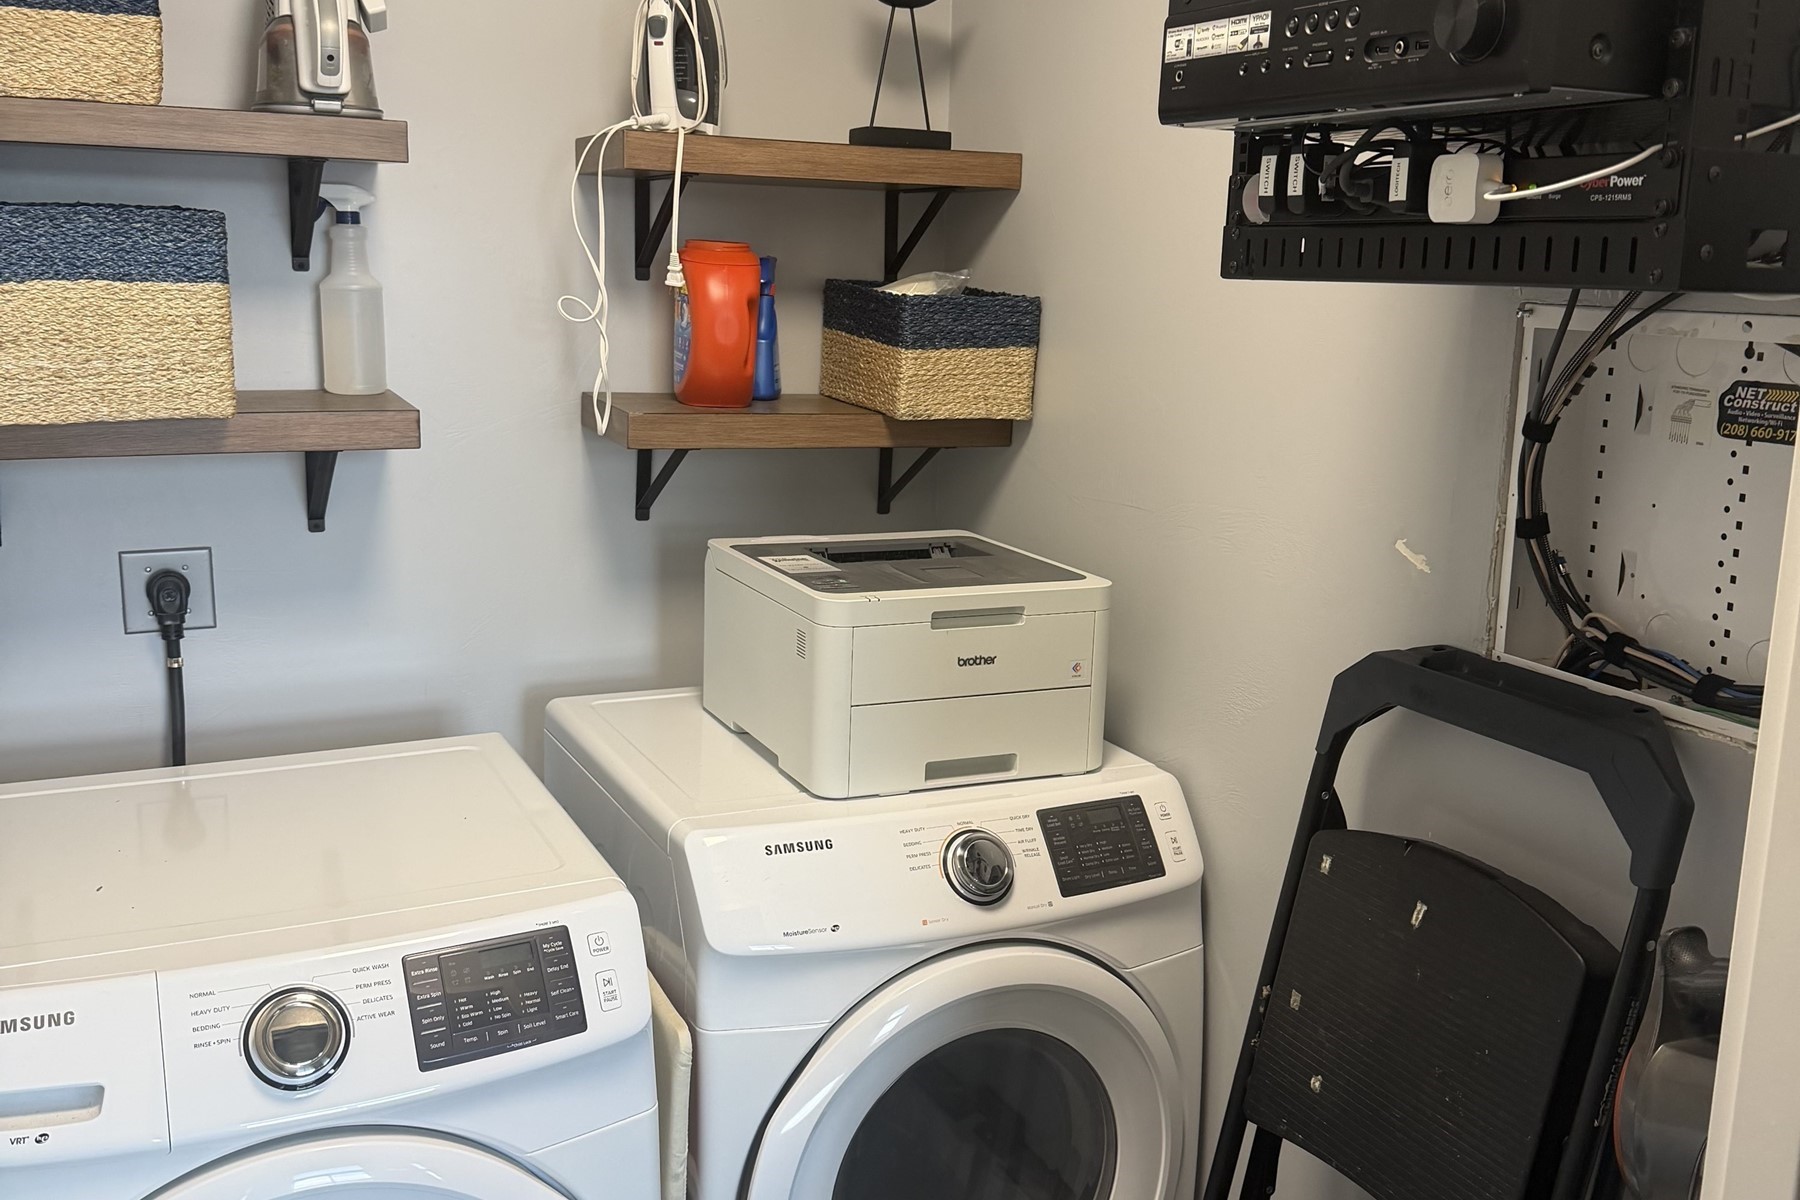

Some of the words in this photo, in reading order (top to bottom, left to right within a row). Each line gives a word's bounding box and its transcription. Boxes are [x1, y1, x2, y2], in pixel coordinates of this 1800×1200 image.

[1264, 157, 1272, 194] SWITCH
[1292, 156, 1301, 193] SWITCH
[1735, 386, 1767, 400] NET
[1723, 394, 1797, 413] Construct
[1727, 408, 1742, 416] Audio
[1720, 422, 1749, 438] (208)
[957, 655, 997, 667] brother
[764, 839, 834, 856] SAMSUNG
[352, 966, 370, 974] QUICK
[371, 963, 390, 971] WASH
[411, 969, 424, 977] Extra
[355, 982, 372, 990] PERM
[374, 979, 392, 987] PRESS
[189, 990, 216, 999] NORMAL
[363, 994, 393, 1005] DELICATES
[417, 993, 430, 1001] Extra
[431, 991, 442, 999] Spin
[191, 1007, 211, 1016] HEAVY
[213, 1006, 230, 1014] DUTY
[356, 1013, 377, 1022] ACTIVE
[421, 1017, 432, 1025] Spin
[433, 1015, 445, 1023] Only
[555, 1013, 569, 1021] Smart
[192, 1023, 221, 1032] BEDDING
[533, 1020, 547, 1028] Level
[430, 1041, 446, 1049] Sound
